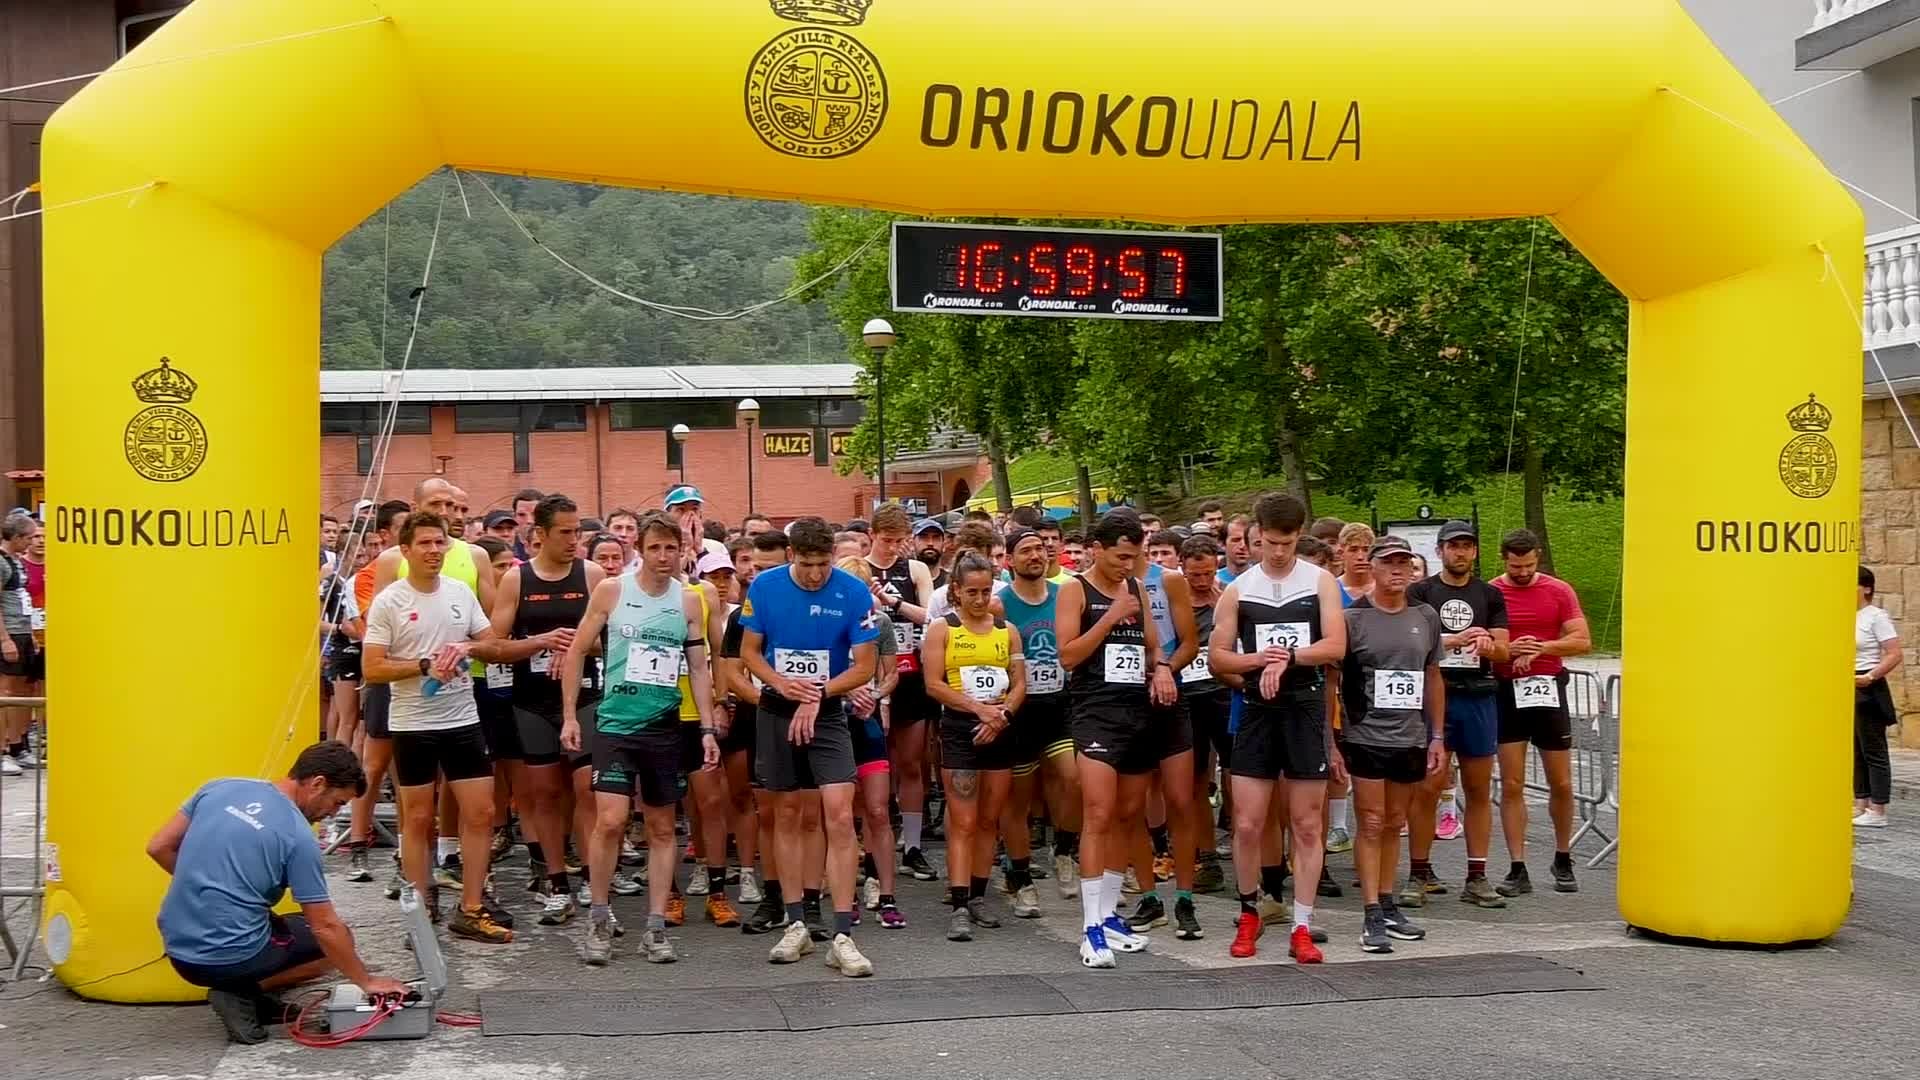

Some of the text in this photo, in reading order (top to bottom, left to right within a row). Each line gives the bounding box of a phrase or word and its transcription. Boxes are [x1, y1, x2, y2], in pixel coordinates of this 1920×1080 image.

[958, 243, 1185, 298] 16:59:57
[765, 437, 810, 453] HAIZE
[1266, 635, 1299, 648] 192
[650, 657, 659, 670] 1
[785, 661, 818, 674] 290
[1115, 656, 1140, 669] 275
[1031, 669, 1057, 681] 154
[976, 676, 995, 688] 50
[1385, 682, 1415, 695] 158
[1523, 685, 1551, 696] 242
